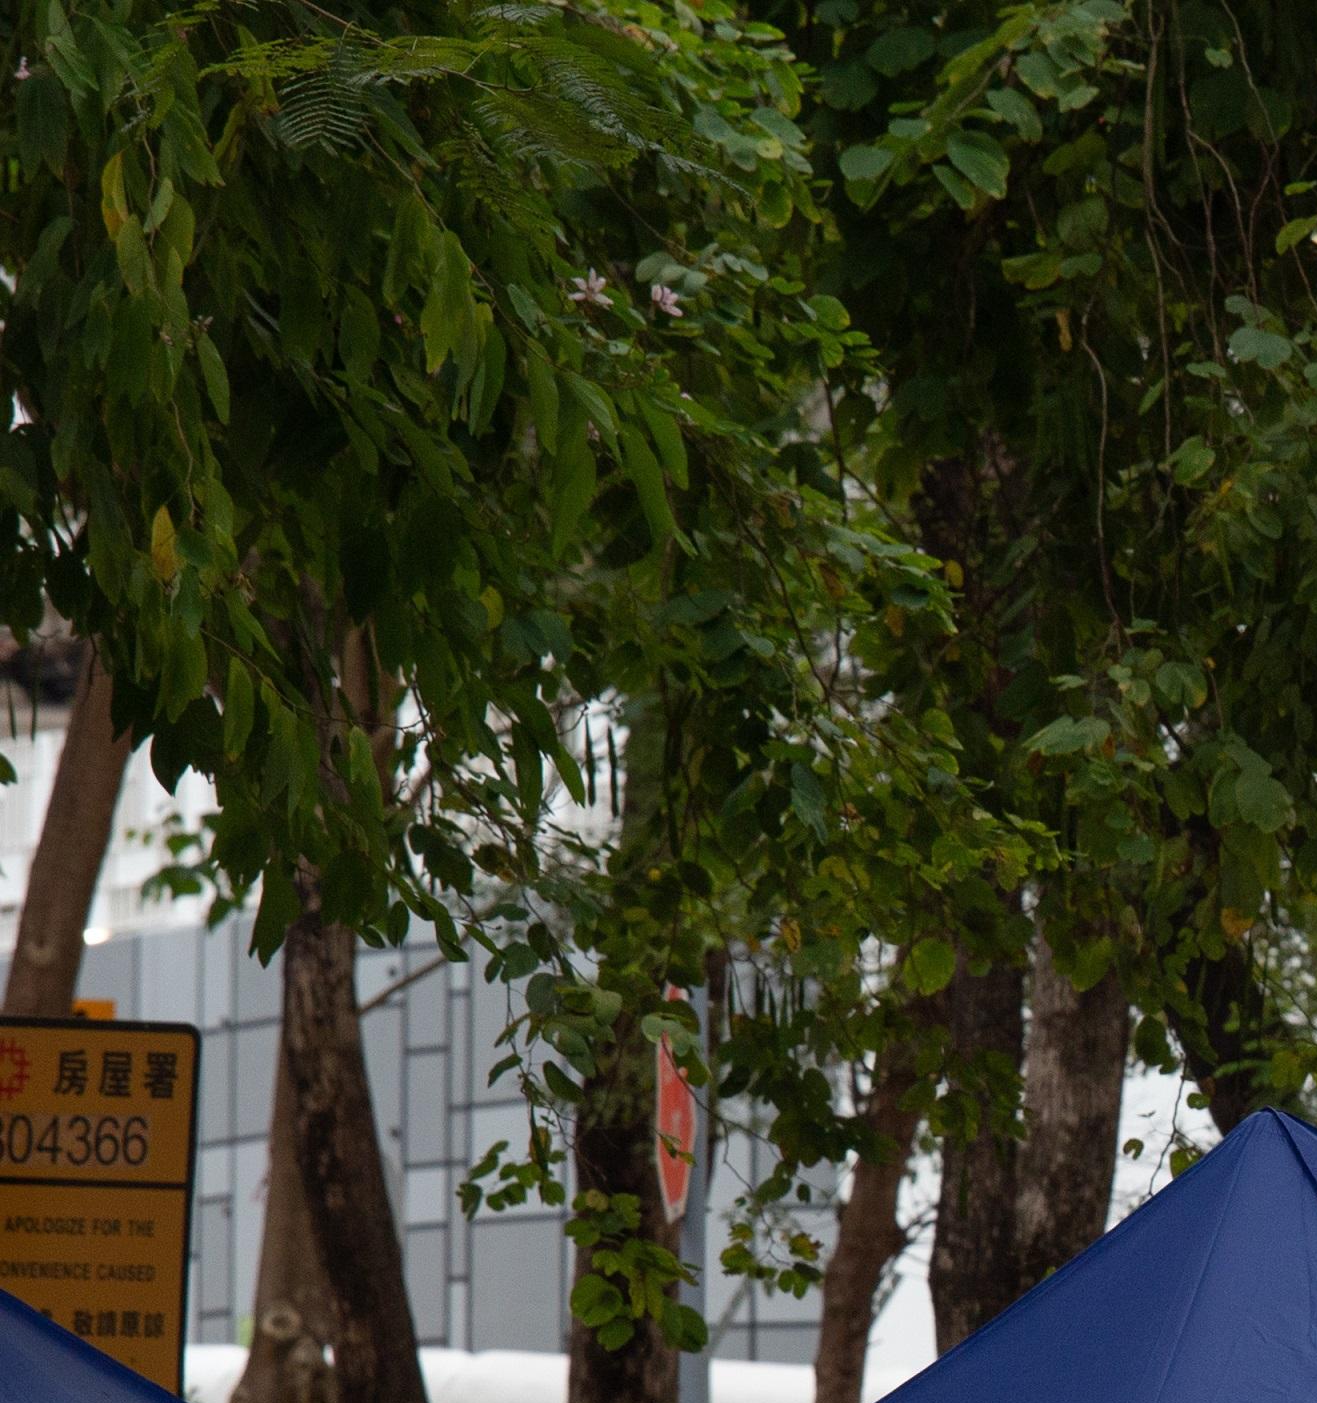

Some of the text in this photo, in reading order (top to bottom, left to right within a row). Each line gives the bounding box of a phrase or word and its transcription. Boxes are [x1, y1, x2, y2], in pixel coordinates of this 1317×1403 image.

[54, 1050, 178, 1098] 房屋署
[0, 1114, 149, 1166] 04366
[92, 1218, 122, 1237] FOR
[127, 1219, 155, 1238] THE
